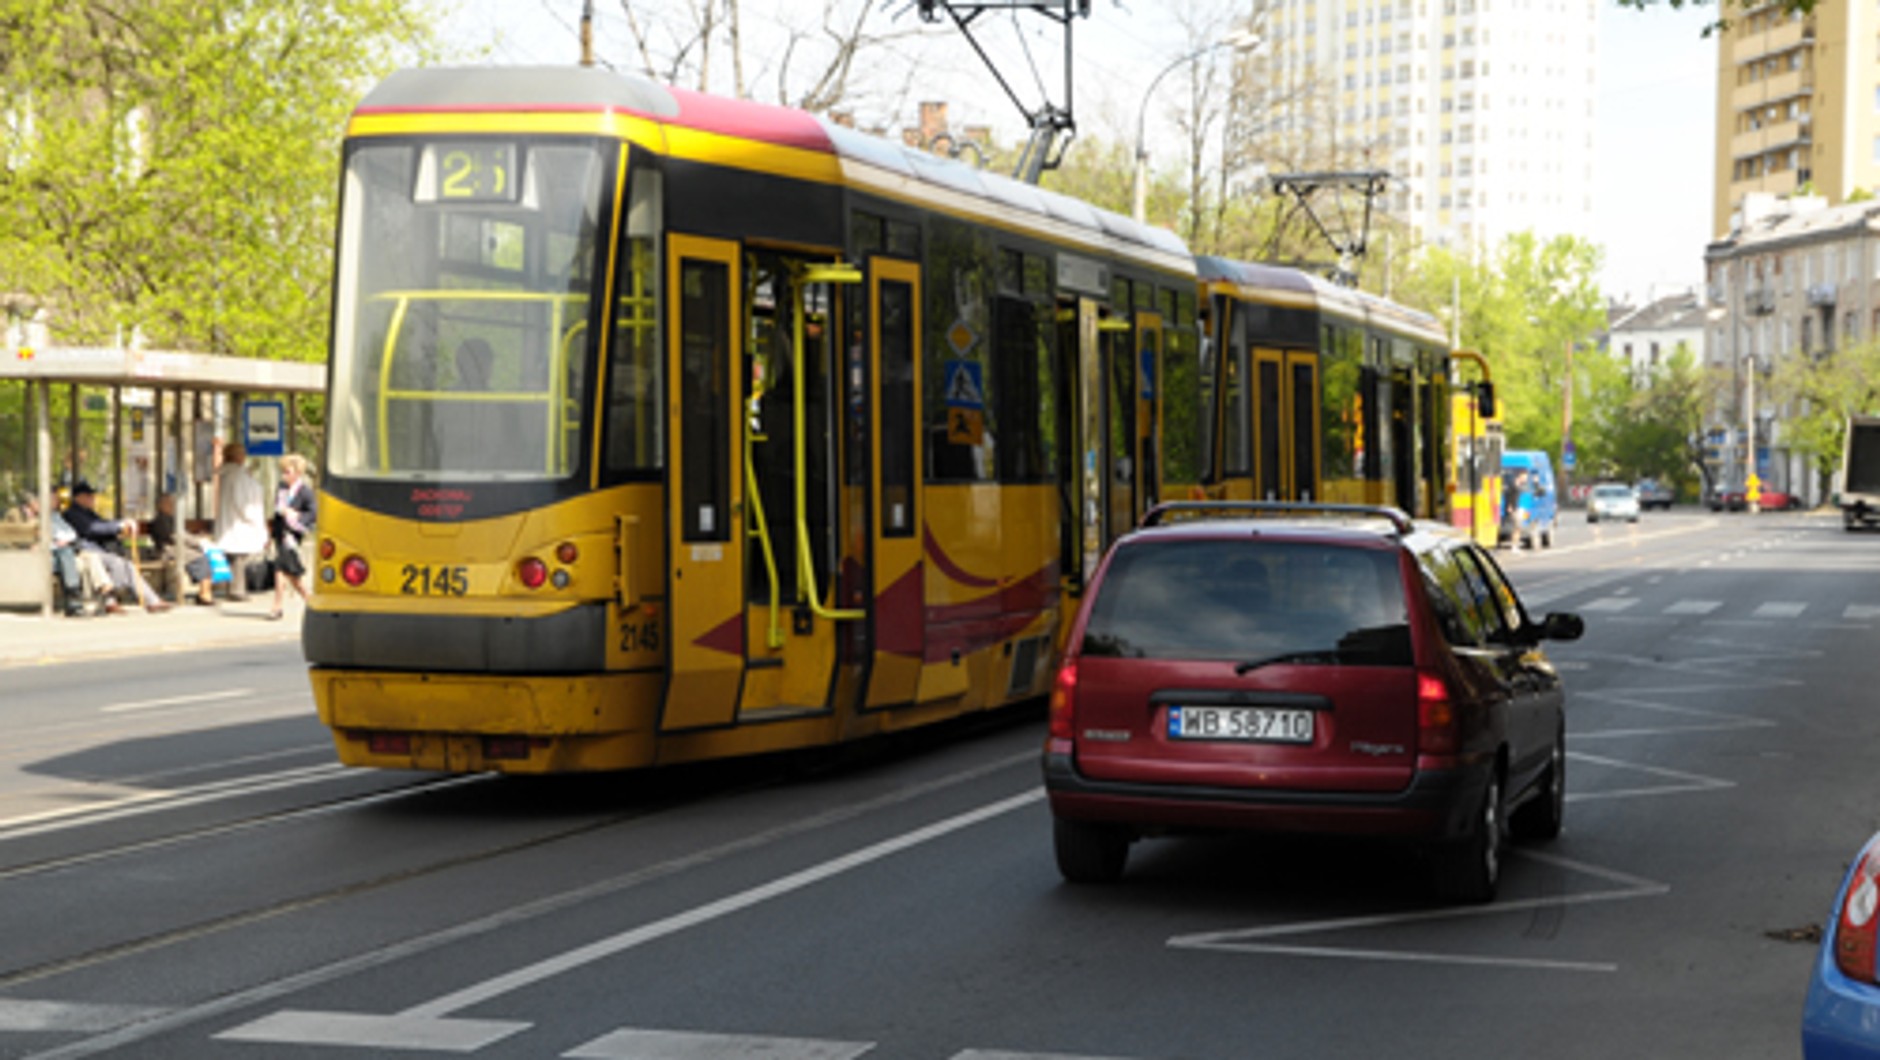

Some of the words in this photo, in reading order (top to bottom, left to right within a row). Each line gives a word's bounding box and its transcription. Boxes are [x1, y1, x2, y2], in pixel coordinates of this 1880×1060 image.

[401, 563, 468, 597] 2145
[620, 622, 658, 652] 2145
[1184, 710, 1219, 734] WB
[1229, 710, 1310, 738] 58710
